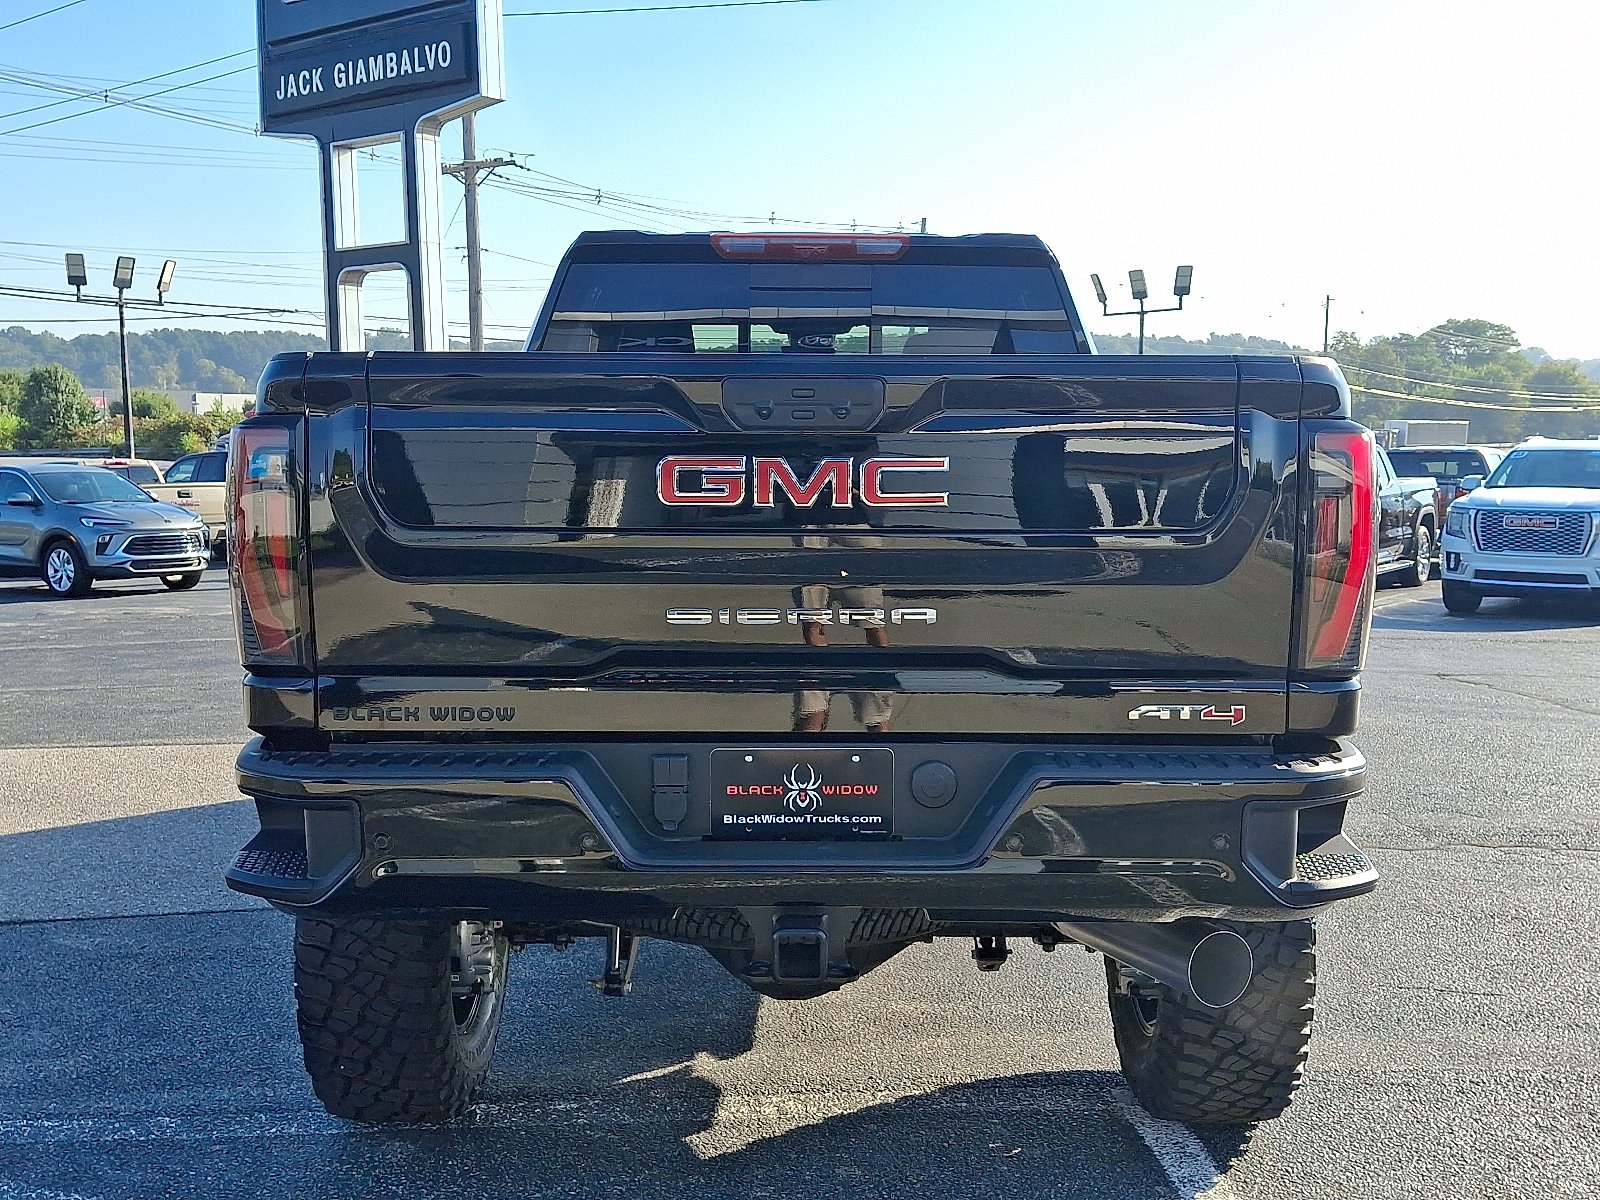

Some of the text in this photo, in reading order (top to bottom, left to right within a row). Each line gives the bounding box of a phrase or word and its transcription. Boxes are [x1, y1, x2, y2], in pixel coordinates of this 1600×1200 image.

[275, 40, 452, 101] JACK GIAMBALVO
[656, 455, 950, 508] GMC
[1506, 516, 1556, 528] GMC
[665, 607, 938, 625] SIERRA
[332, 706, 516, 722] BLACK WIDOW
[1128, 704, 1246, 726] AT4
[726, 785, 879, 796] BLACK WIDOW
[723, 813, 882, 824] BlackWidowTrucks.com
